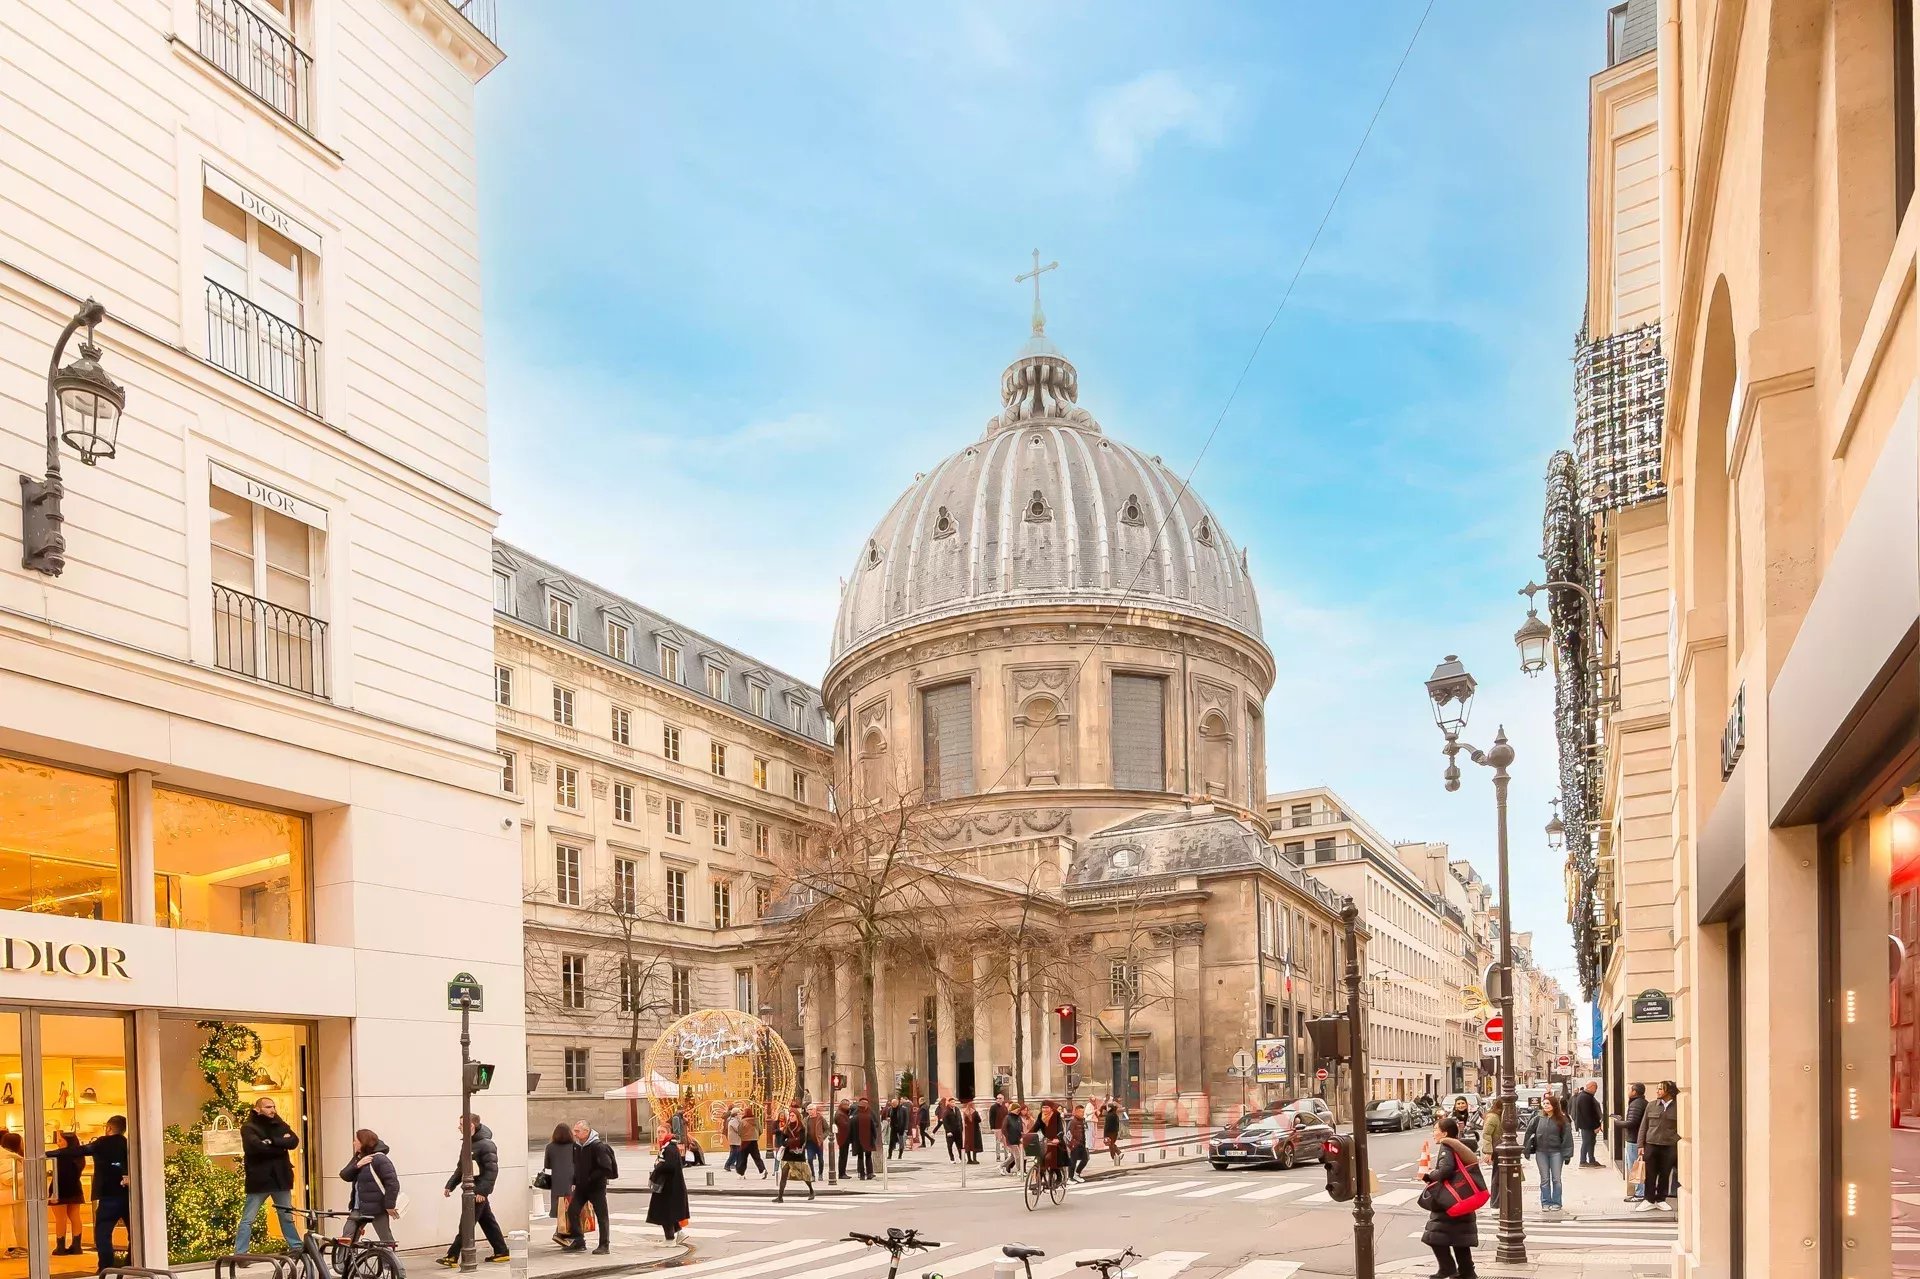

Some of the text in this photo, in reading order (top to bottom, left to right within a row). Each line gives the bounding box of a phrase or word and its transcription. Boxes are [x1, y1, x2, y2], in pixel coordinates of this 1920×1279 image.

[241, 190, 291, 234] DIOR
[247, 481, 296, 514] DIOR
[0, 936, 133, 979] DIOR
